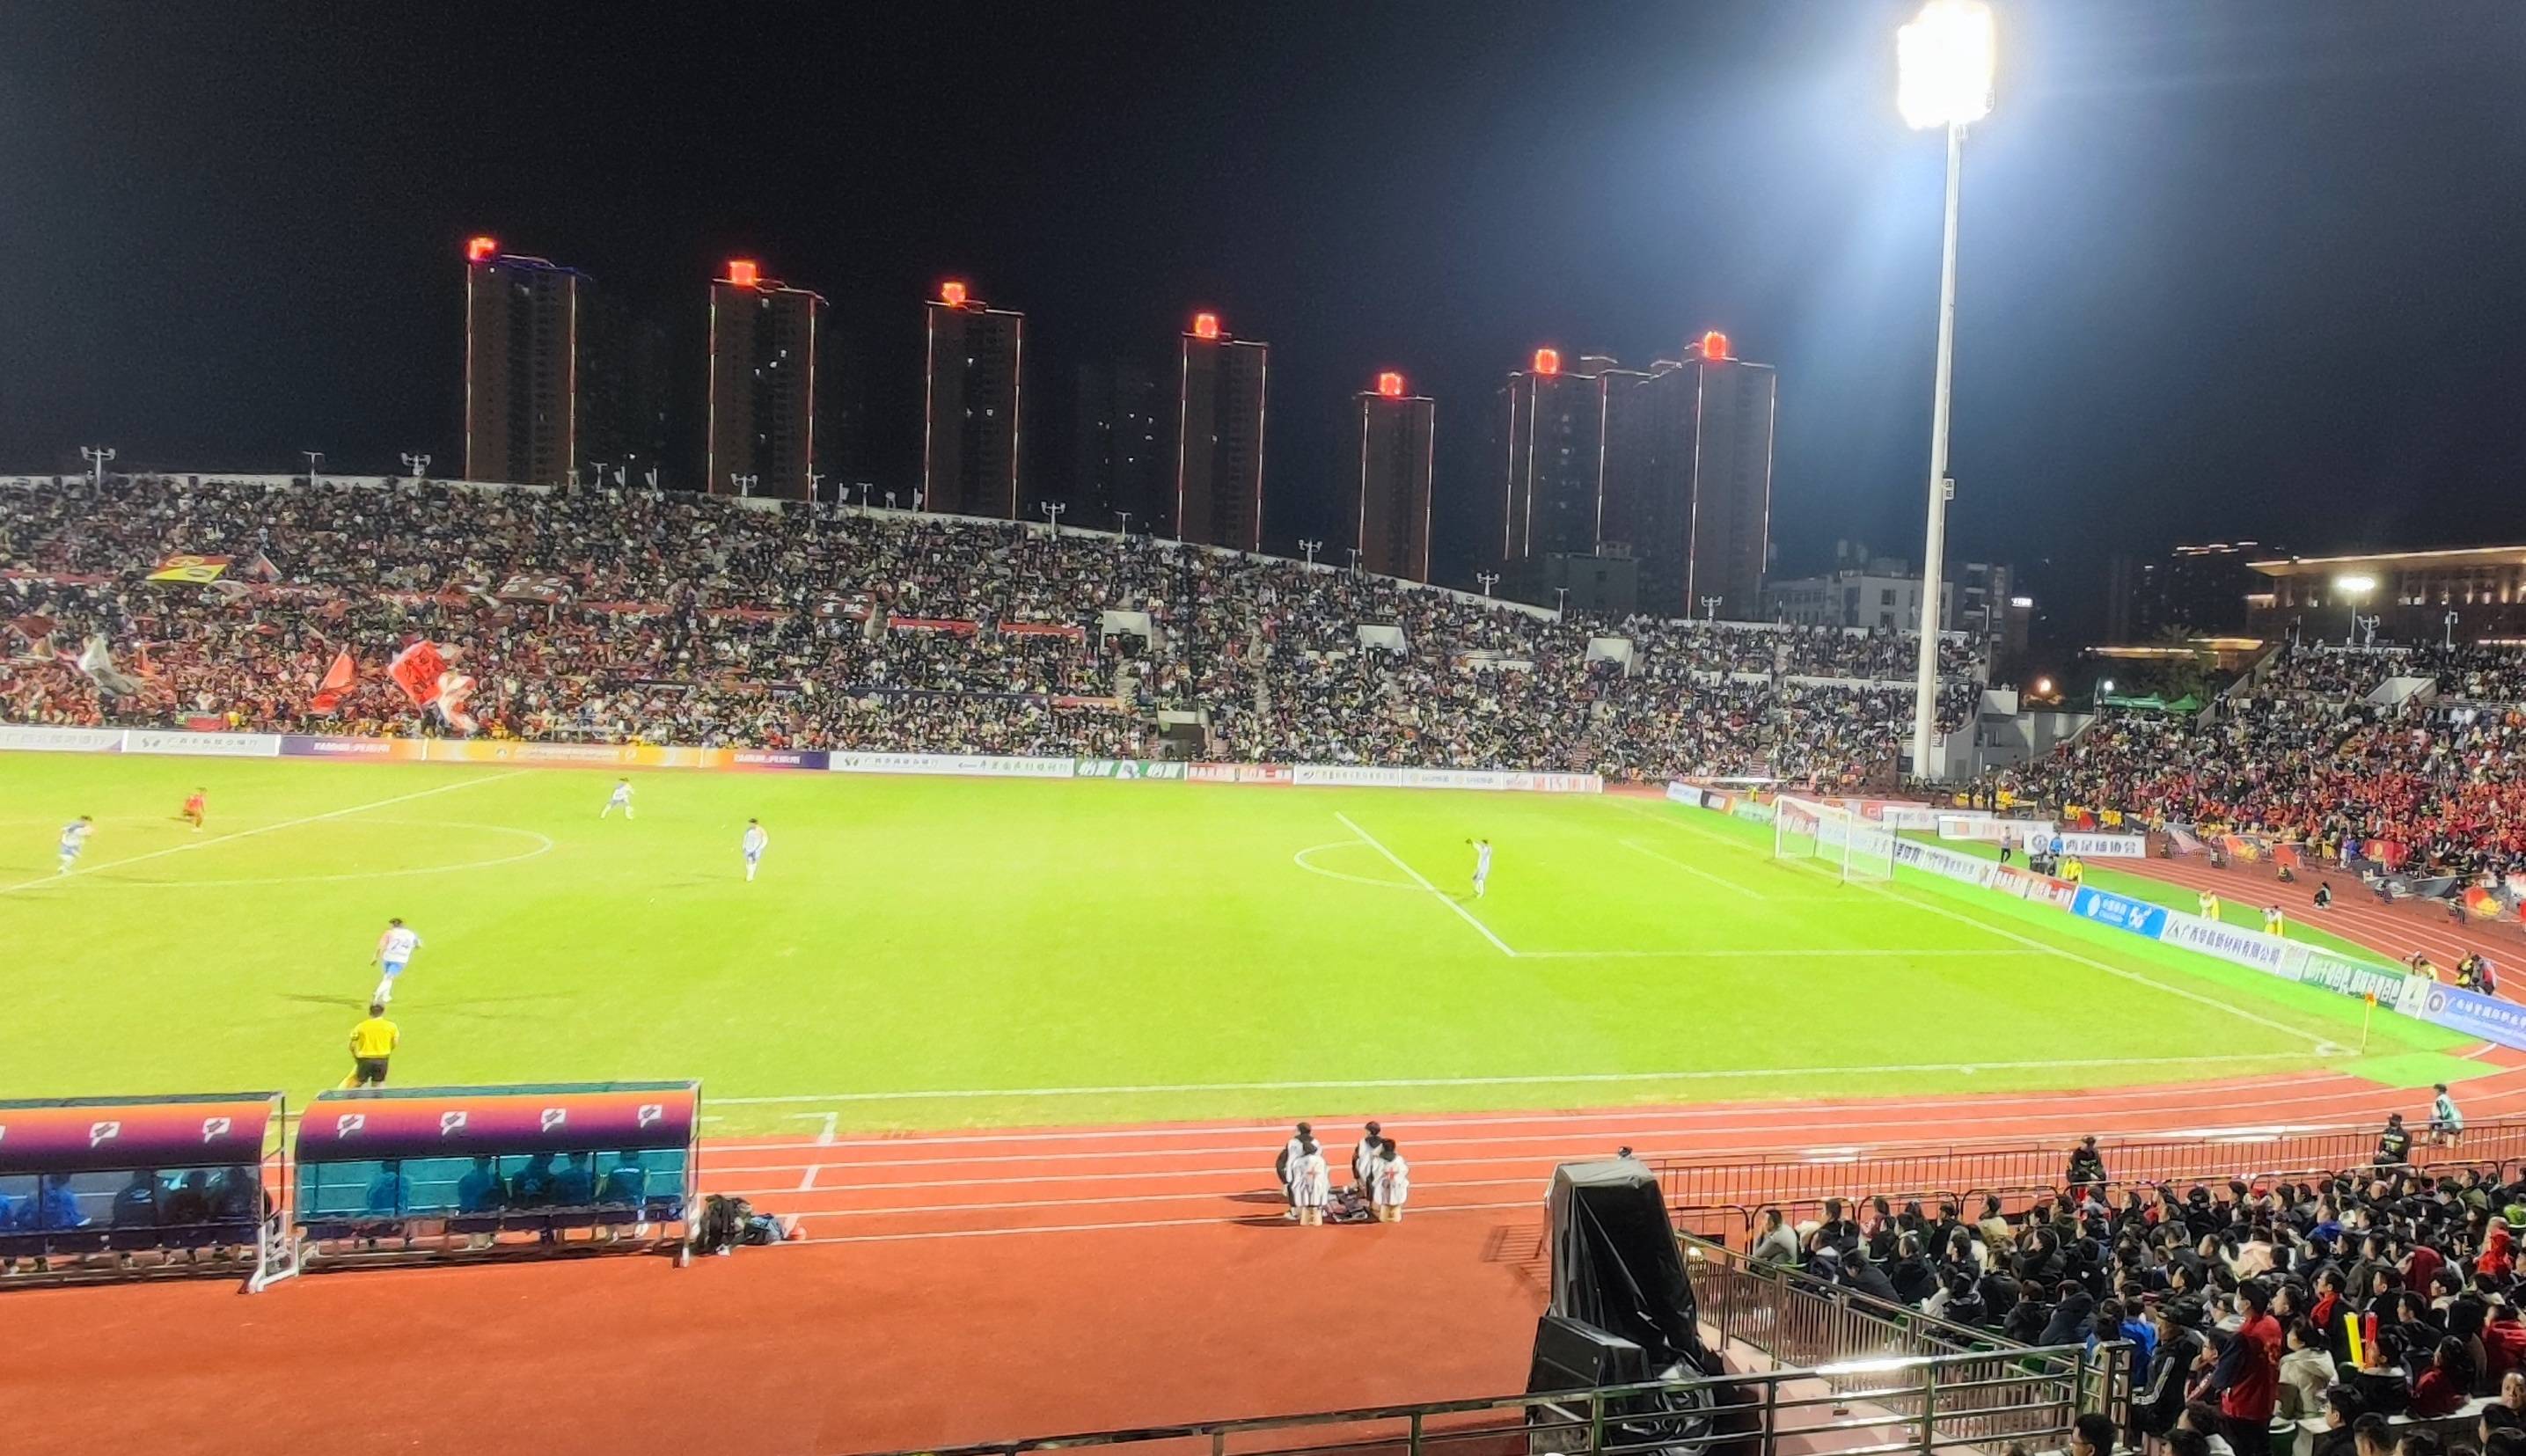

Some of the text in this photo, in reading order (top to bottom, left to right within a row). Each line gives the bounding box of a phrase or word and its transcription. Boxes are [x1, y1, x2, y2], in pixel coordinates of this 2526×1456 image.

[2066, 838, 2136, 854] 西足球协会
